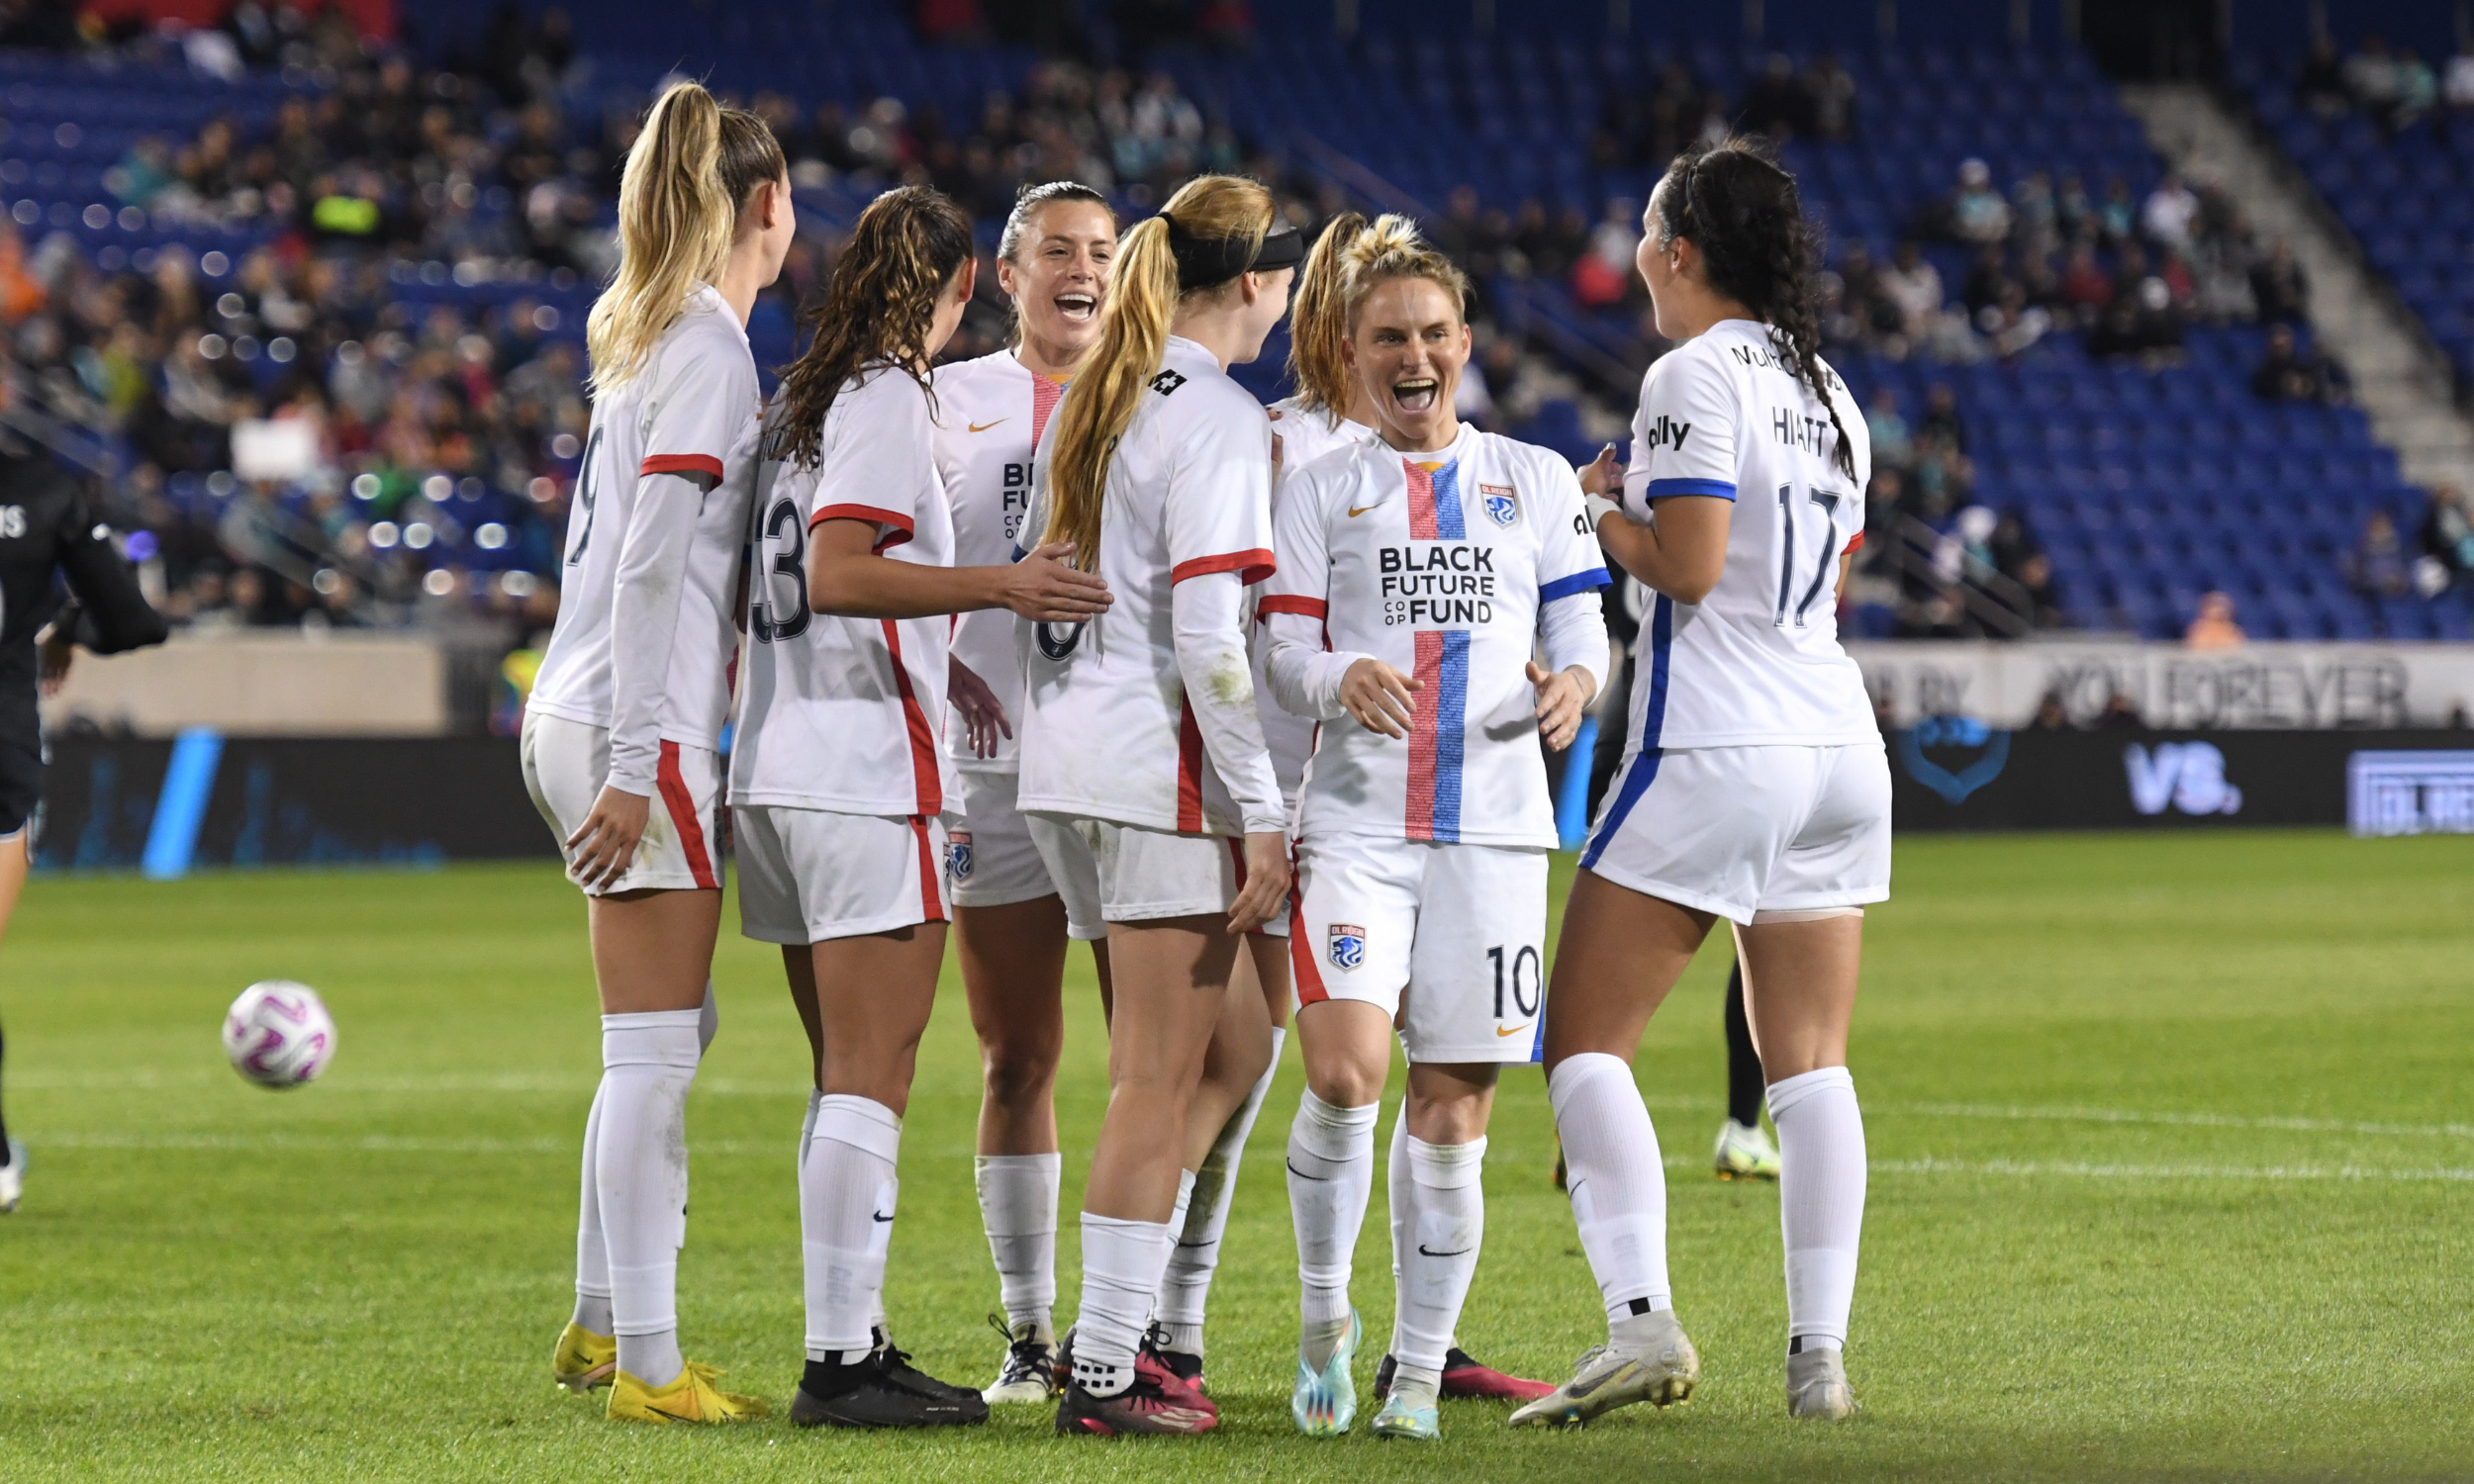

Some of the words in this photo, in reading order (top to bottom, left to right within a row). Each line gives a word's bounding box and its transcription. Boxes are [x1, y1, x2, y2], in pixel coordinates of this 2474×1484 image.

[1649, 415, 1691, 451] ally
[1772, 407, 1828, 457] HIATT
[567, 424, 604, 567] 9
[0, 505, 27, 538] S
[1380, 546, 1494, 573] BLACK
[1774, 482, 1842, 629] 17
[1381, 575, 1494, 598] FUTURE
[1384, 602, 1405, 612] CO
[1384, 614, 1406, 625] OP
[1410, 600, 1492, 624] FUND
[1486, 945, 1540, 1019] 10
